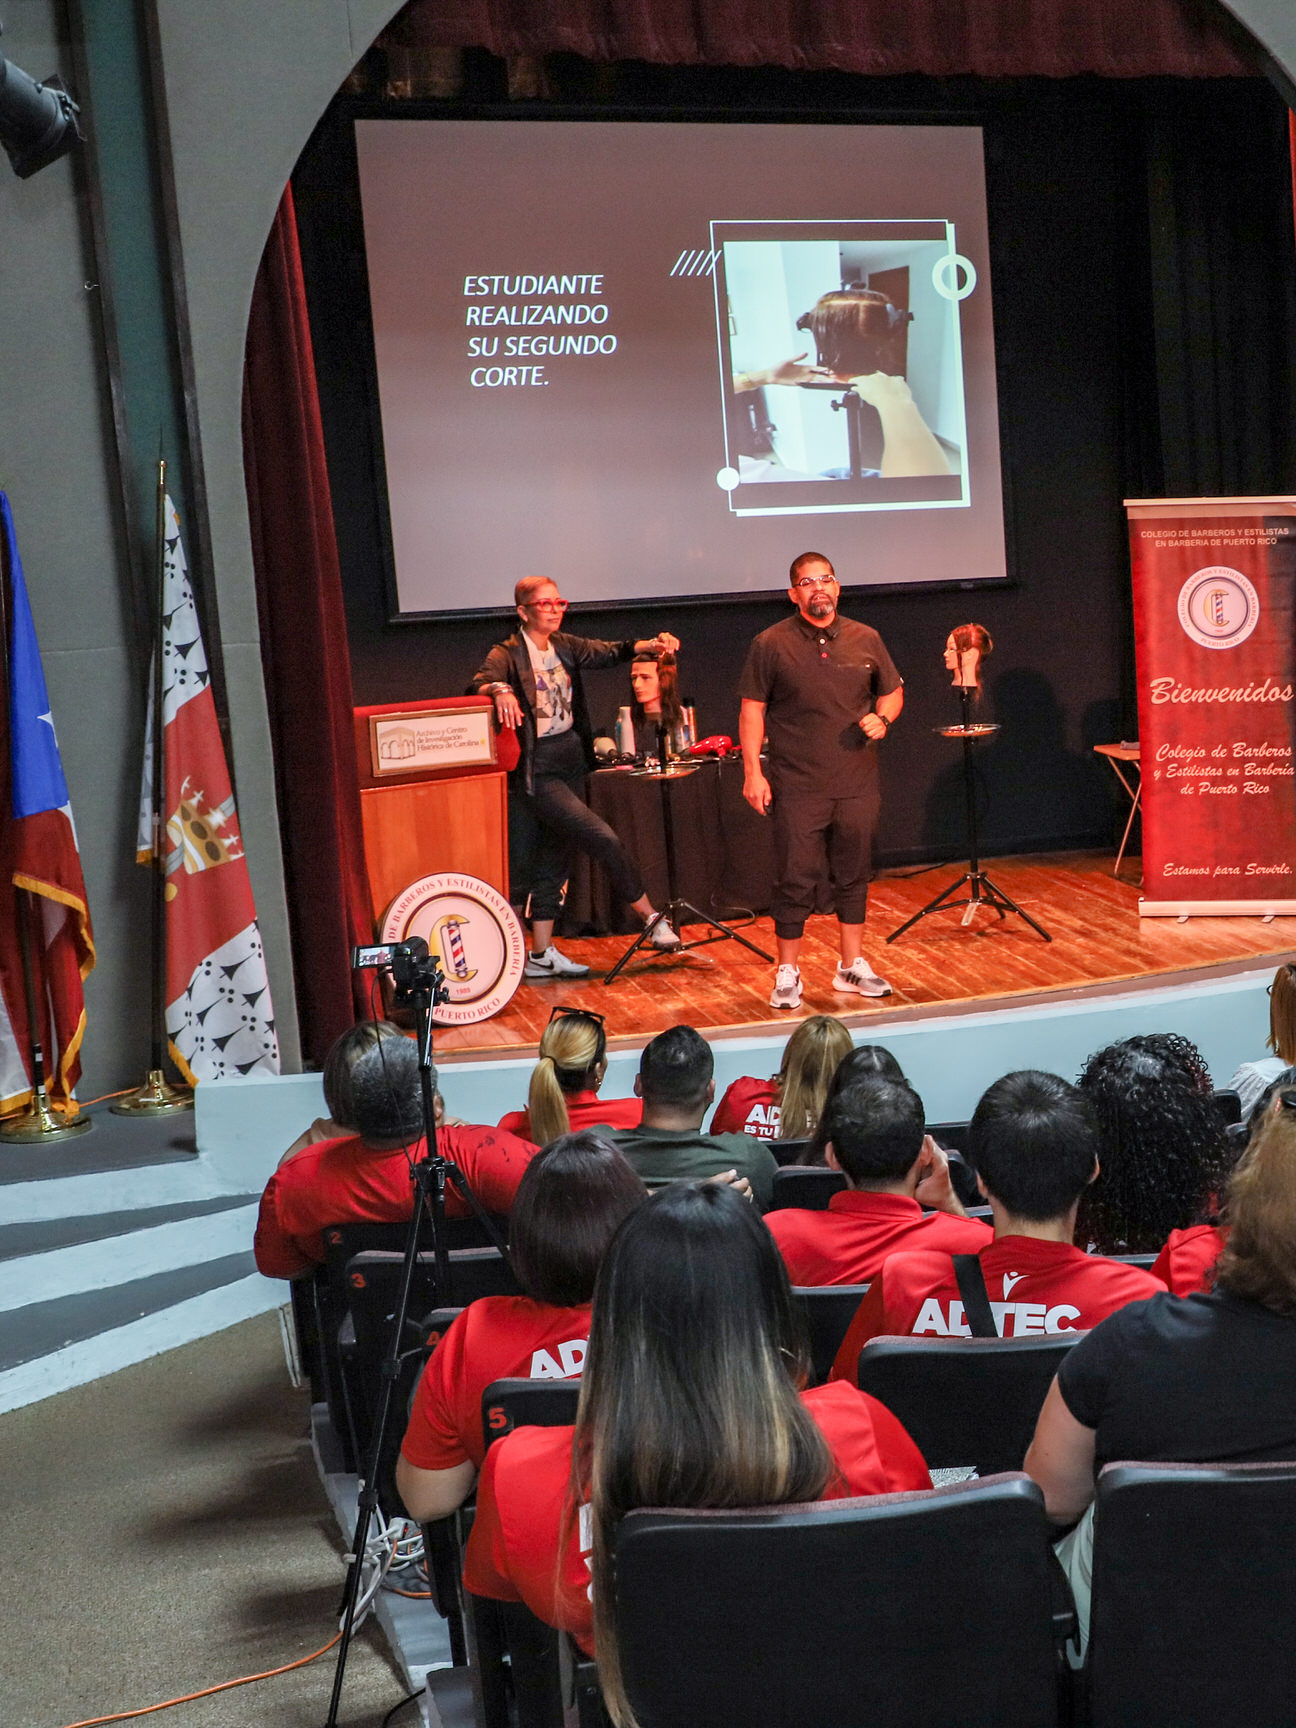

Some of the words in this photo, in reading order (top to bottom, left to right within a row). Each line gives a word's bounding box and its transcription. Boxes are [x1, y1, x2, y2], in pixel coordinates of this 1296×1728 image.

[463, 274, 604, 296] ESTUDIANTE
[466, 304, 609, 326] REALIZANDO
[467, 337, 499, 357] SU
[503, 334, 618, 356] SEGUNDO
[470, 366, 550, 387] CORTE.
[1140, 530, 1177, 538] COLEGIO
[1191, 529, 1236, 537] BARBEROS
[1237, 528, 1243, 536] Y
[1244, 528, 1289, 536] ESTILISTAS
[1155, 539, 1166, 547] EN
[1211, 538, 1222, 546] DE
[1223, 538, 1255, 546] PUERTO
[1257, 537, 1277, 545] RICO
[1150, 677, 1294, 704] Bienvenidos
[1155, 743, 1206, 763] Colegio
[1211, 744, 1227, 758] de
[1232, 742, 1293, 758] Barberos
[1153, 768, 1162, 780] y
[1166, 763, 1222, 778] Estilistas
[1227, 768, 1239, 776] en
[1244, 762, 1295, 776] Barbería
[1180, 783, 1194, 795] de
[1199, 782, 1238, 795] Puerto
[1242, 781, 1270, 795] Rico
[1163, 863, 1210, 877] Estamos
[1213, 865, 1240, 878] para
[1244, 863, 1293, 876] Servirle.
[388, 927, 397, 939] DE
[393, 883, 436, 923] BARBEROS
[437, 879, 444, 888] Y
[446, 878, 500, 907] ESTILISTAS
[498, 905, 510, 921] EN
[434, 1007, 476, 1020] PUERTO
[477, 998, 501, 1015] RICO
[744, 1124, 757, 1134] ES
[759, 1126, 774, 1136] TU
[330, 1231, 341, 1244] 2
[351, 1273, 366, 1288] 3
[488, 1407, 507, 1429] 5
